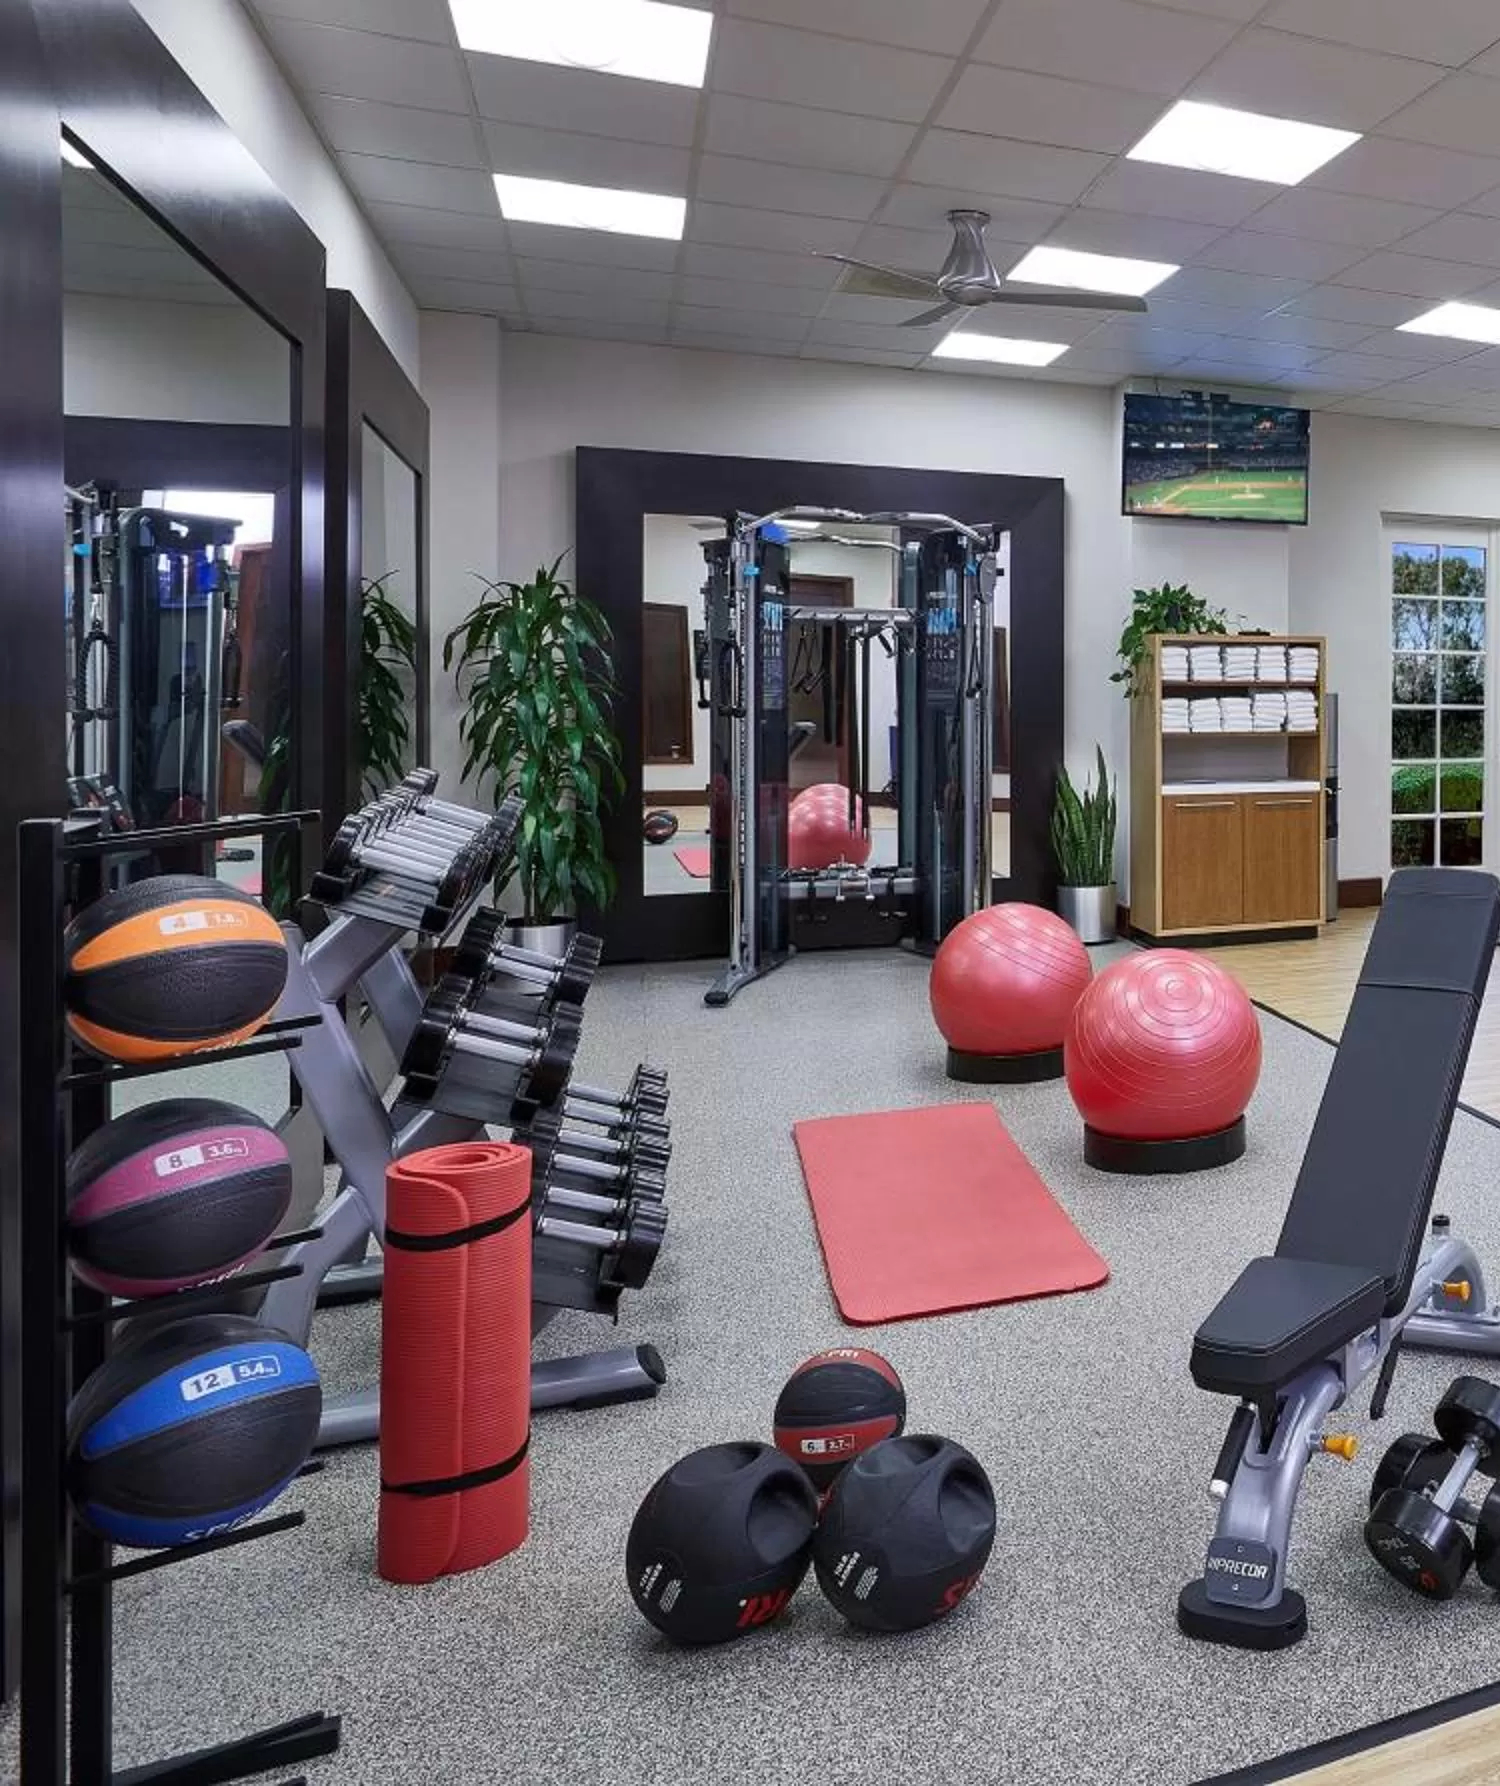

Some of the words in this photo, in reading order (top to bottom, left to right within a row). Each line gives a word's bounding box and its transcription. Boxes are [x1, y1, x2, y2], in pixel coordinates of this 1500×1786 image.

[169, 1154, 182, 1169] 8
[190, 1373, 220, 1393] 12
[1217, 1557, 1269, 1580] PRECOR
